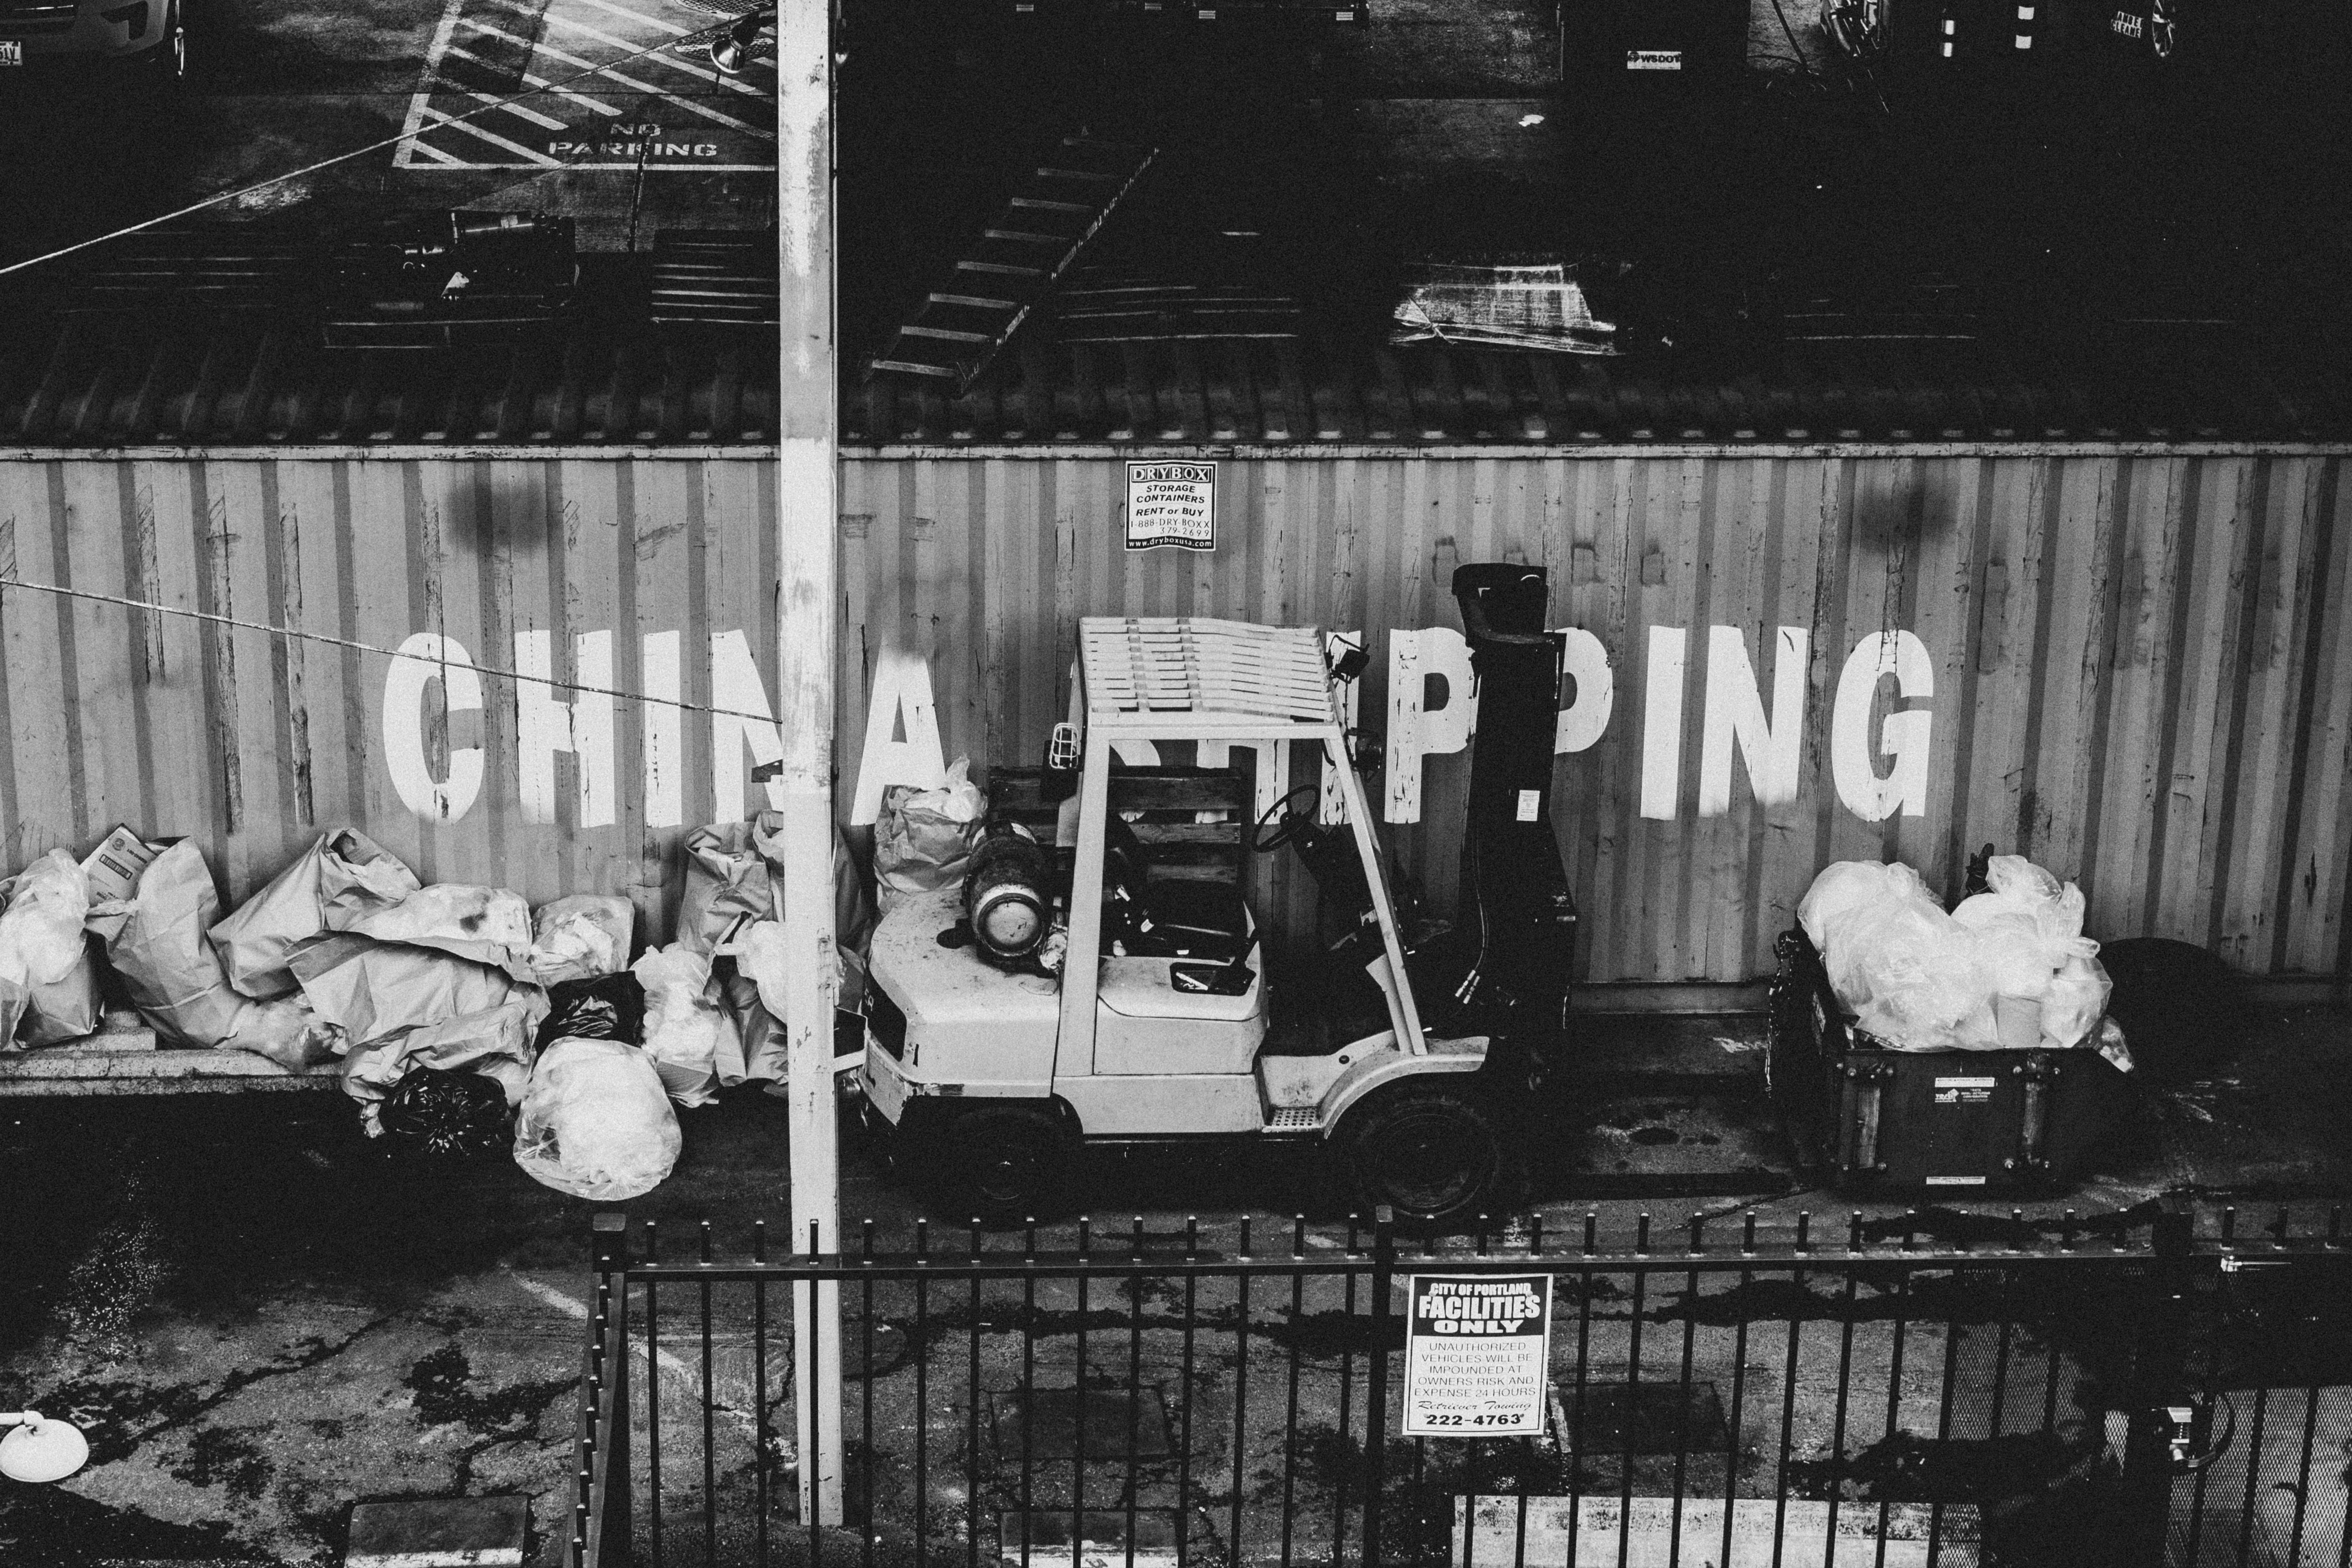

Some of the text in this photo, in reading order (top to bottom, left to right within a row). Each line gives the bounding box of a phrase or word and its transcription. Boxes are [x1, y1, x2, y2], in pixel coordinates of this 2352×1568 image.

[1641, 55, 1680, 63] WSDOT
[611, 123, 661, 136] NO
[549, 141, 717, 156] PARKING
[1133, 467, 1207, 481] DRYBOX
[1146, 484, 1196, 493] STORAGE
[1136, 494, 1205, 503] CONTAINERS
[1136, 508, 1165, 516] RENT
[1182, 508, 1204, 516] BUY
[1160, 527, 1209, 537] 379-2699
[1129, 536, 1212, 547] www.dryboxusa.com
[383, 625, 1934, 829] CHINA IPING
[1430, 1283, 1532, 1296] CITY OF PORTLAND
[1419, 1295, 1540, 1319] FACILITIES
[1434, 1320, 1524, 1333] ONLY
[1429, 1342, 1526, 1351] UNAUTHORIZED
[1422, 1353, 1533, 1363] VEHICLES WILL BE
[1430, 1365, 1523, 1374] IMPOUNDED AT
[1418, 1376, 1534, 1386] OWNERS RISK AND
[1414, 1387, 1536, 1397] EXPENSE 24 HOURS
[1418, 1401, 1531, 1412] Retriever Towing
[1426, 1413, 1522, 1426] 222-4763
